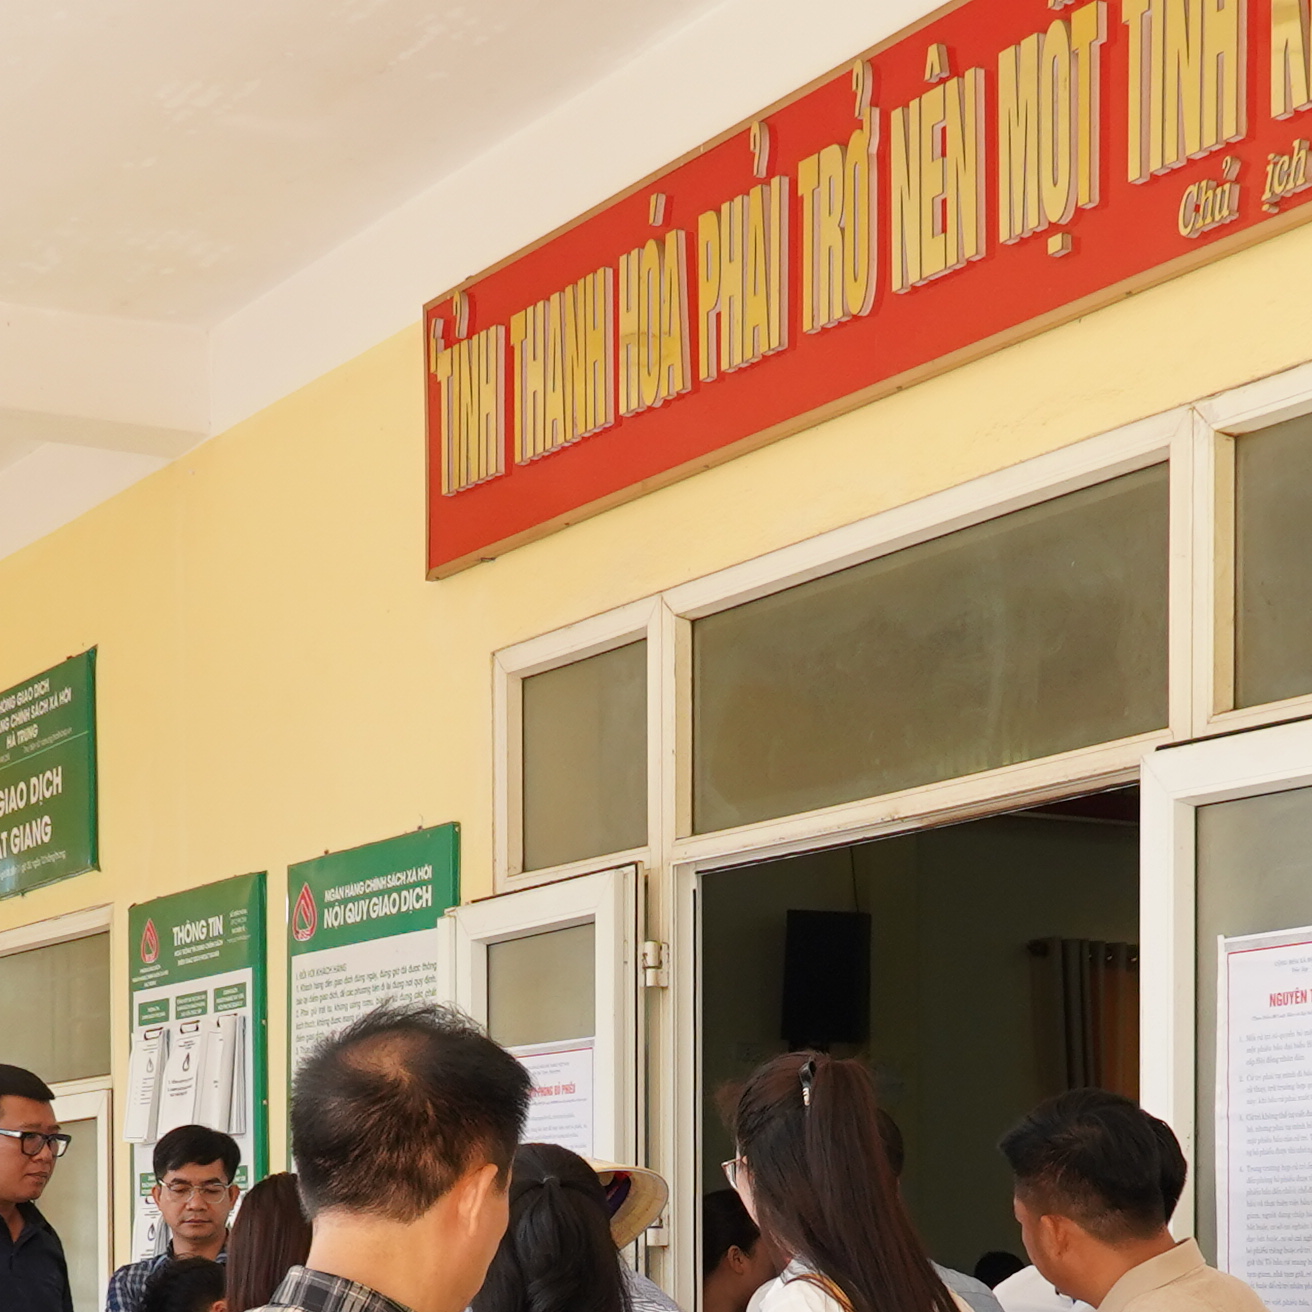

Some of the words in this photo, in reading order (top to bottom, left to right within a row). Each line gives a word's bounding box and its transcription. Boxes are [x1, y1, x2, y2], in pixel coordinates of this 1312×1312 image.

[1178, 155, 1240, 238] Chủ
[510, 266, 615, 466] THANH
[697, 119, 790, 382] PHẢI
[797, 59, 880, 334] TRỞ
[890, 43, 986, 294] NÊN
[30, 766, 62, 805] DỊCH
[10, 815, 52, 854] GIANG
[324, 902, 344, 930] NỘI
[346, 899, 370, 925] QUY
[370, 892, 399, 919] GIAO
[401, 885, 432, 914] DỊCH
[172, 920, 207, 946] THÔNG
[208, 915, 223, 937] TIN
[1269, 987, 1307, 1007] NGUYÊN
